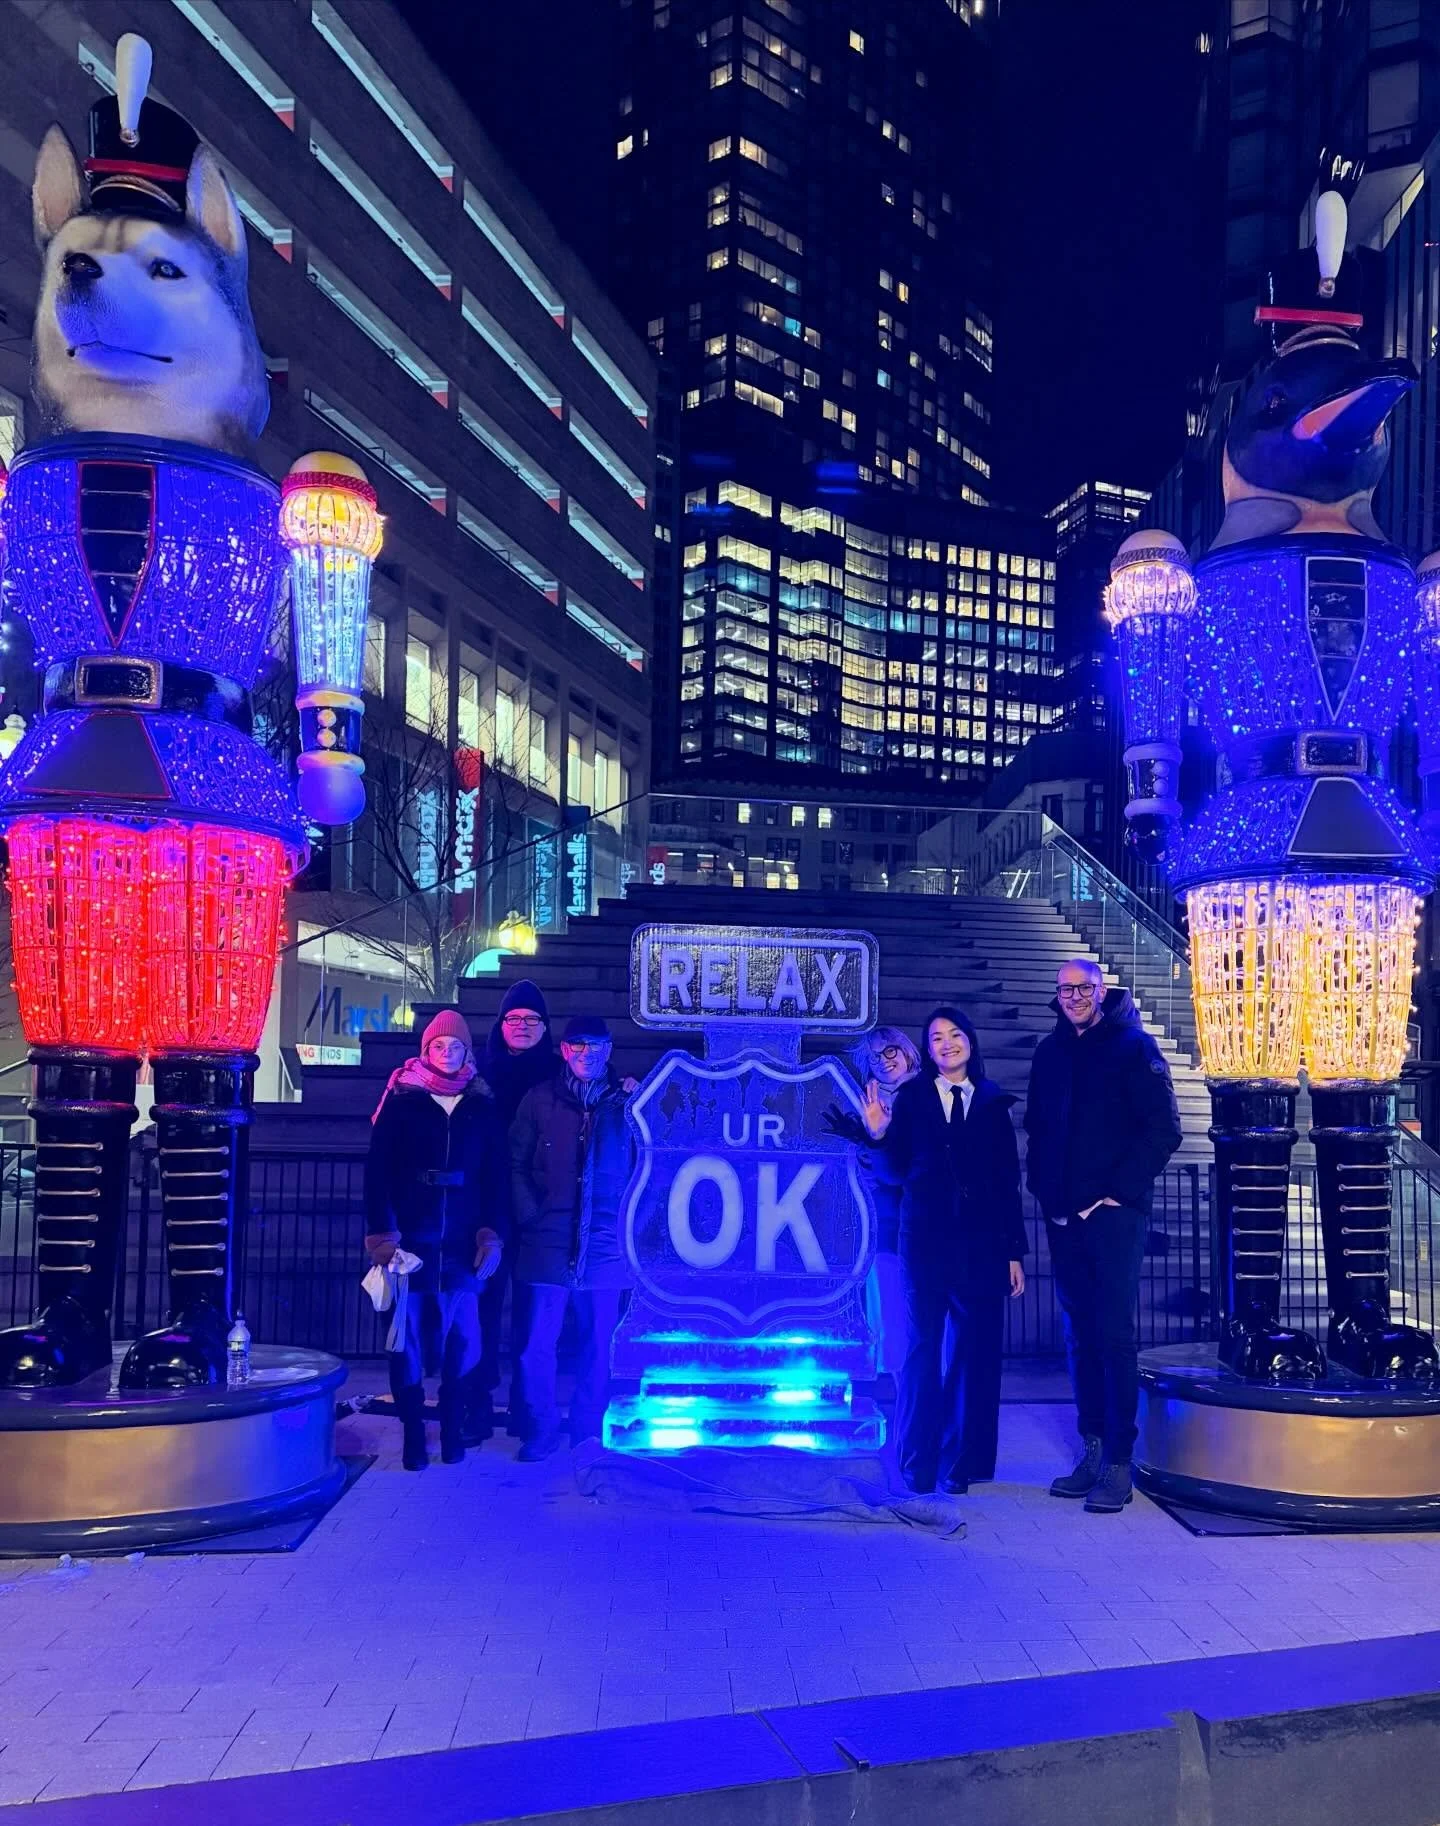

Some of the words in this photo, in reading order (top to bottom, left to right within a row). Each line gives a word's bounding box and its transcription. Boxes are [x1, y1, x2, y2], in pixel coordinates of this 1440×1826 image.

[659, 951, 847, 1011] RELAX
[722, 1113, 785, 1147] UR
[668, 1154, 830, 1273] OK
